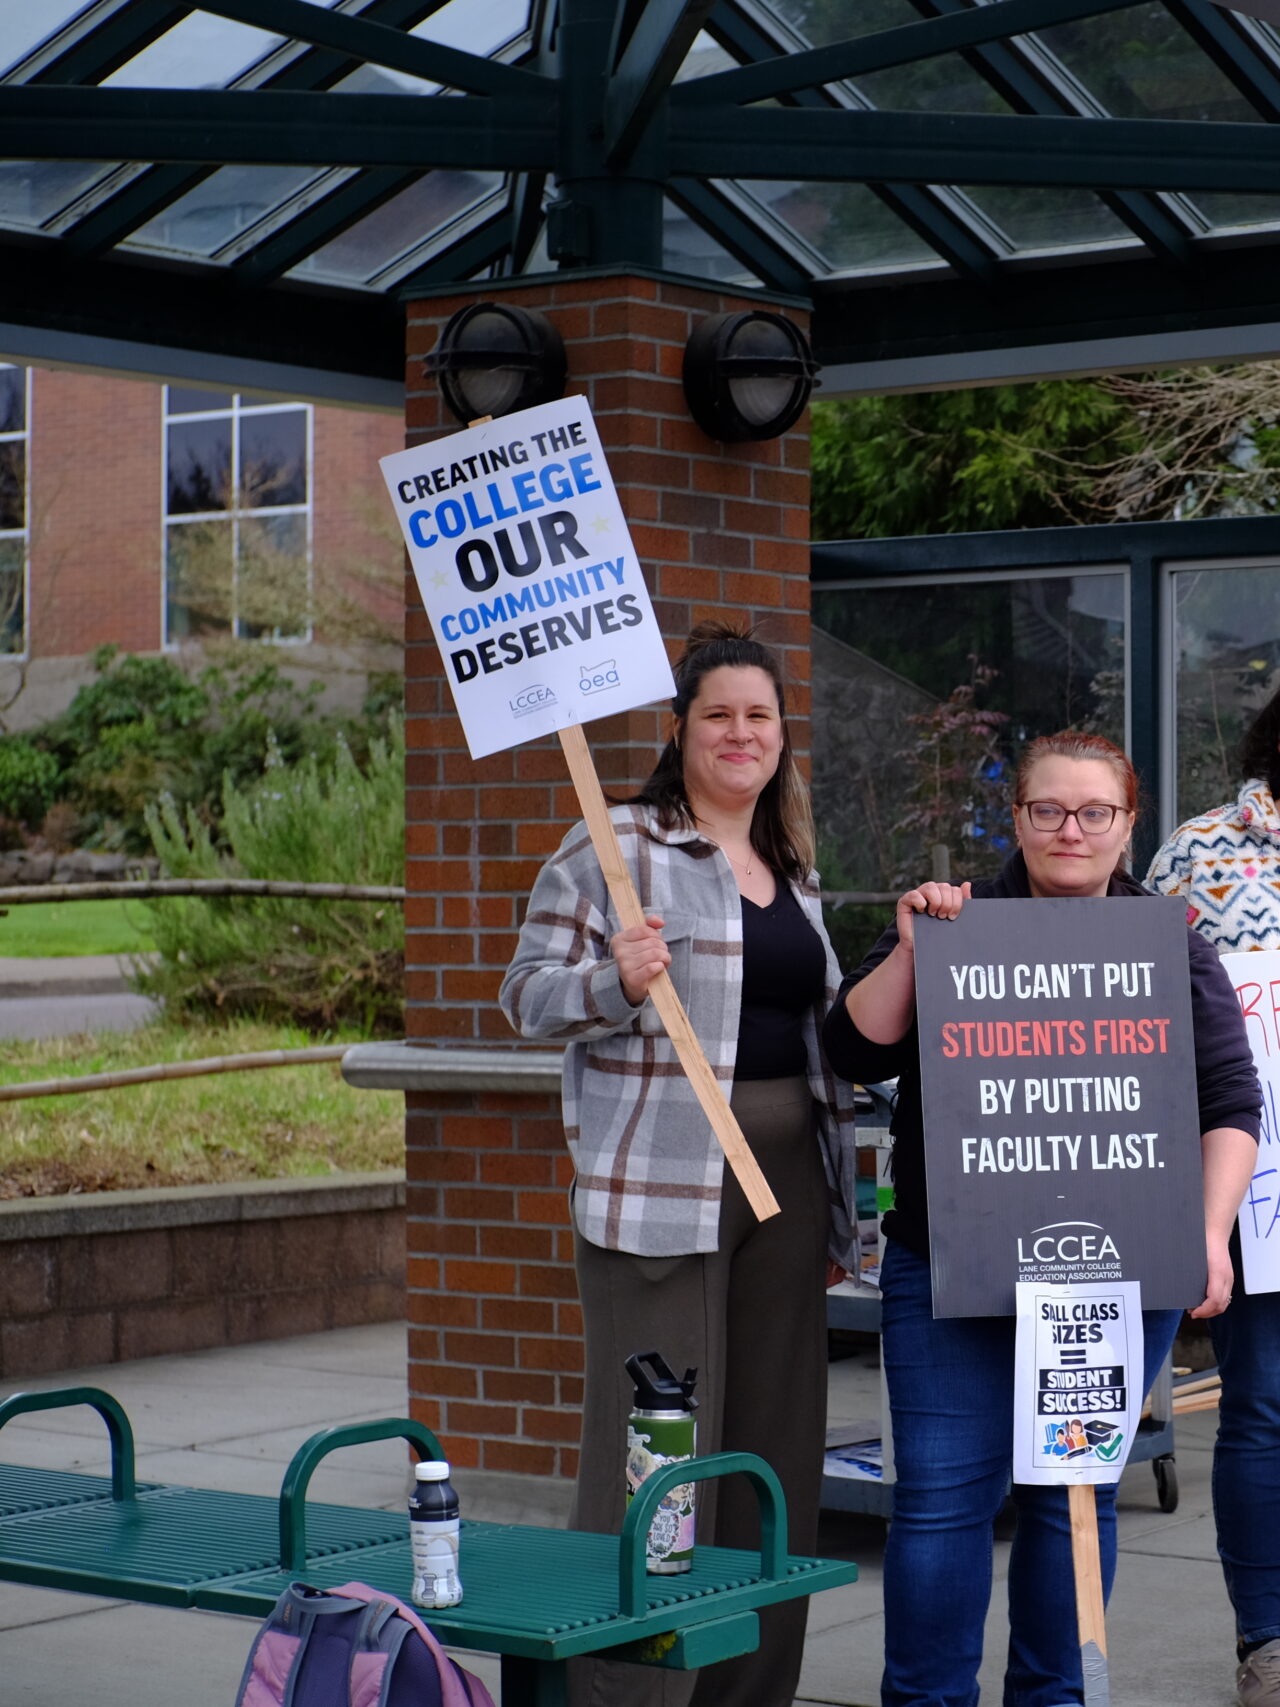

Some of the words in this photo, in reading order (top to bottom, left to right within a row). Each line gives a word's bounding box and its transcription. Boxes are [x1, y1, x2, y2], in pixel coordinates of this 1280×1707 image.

[397, 440, 530, 504] CREATING
[530, 421, 587, 457] THE
[408, 452, 602, 549] COLLEGE
[455, 510, 590, 593] OUR
[440, 556, 625, 641] COMMUNITY
[450, 593, 643, 683] DESERVES
[509, 687, 556, 711] LCCEA
[579, 670, 620, 691] oea
[949, 964, 1005, 1000] YOU
[1013, 963, 1095, 998] CAN'T
[1104, 962, 1155, 997] PUT
[941, 1020, 1086, 1057] STUDENTS
[1093, 1018, 1170, 1054] FIRST
[979, 1079, 1016, 1115] BY
[1024, 1076, 1141, 1113] PUTTING
[961, 1135, 1082, 1173] FACULTY
[1090, 1133, 1165, 1169] LAST.
[1017, 1234, 1121, 1263] LCCEA
[1019, 1265, 1039, 1273] LANE
[1039, 1263, 1085, 1272] COMMUNITY
[1086, 1262, 1121, 1270] COLLEGE
[1019, 1273, 1066, 1282] EDUCATION
[1068, 1271, 1122, 1280] ASSOCIATION
[1072, 1303, 1119, 1322] CLASS
